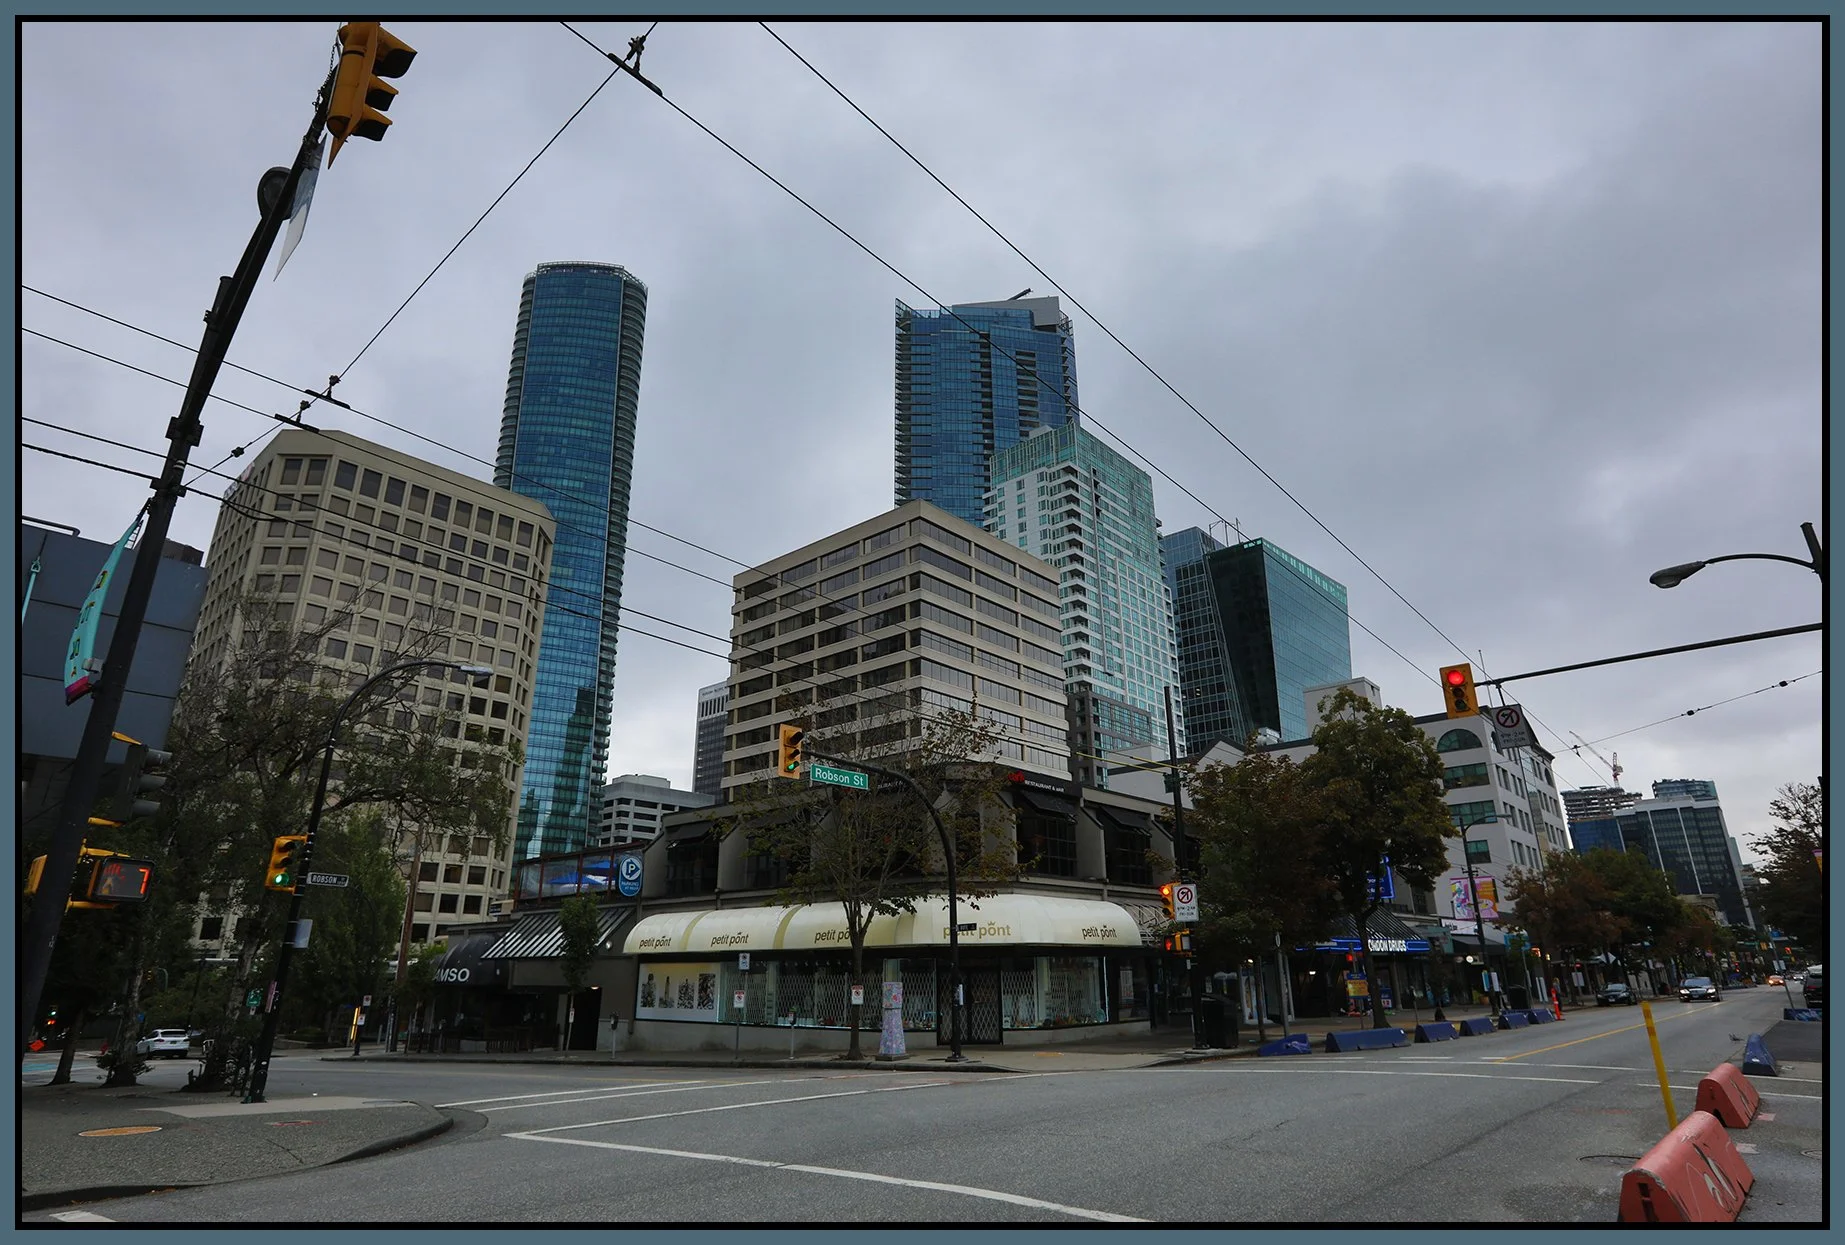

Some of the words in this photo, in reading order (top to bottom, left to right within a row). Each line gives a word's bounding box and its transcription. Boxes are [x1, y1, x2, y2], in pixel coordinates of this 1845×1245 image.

[815, 768, 850, 783] Robson
[853, 775, 864, 786] St
[312, 875, 338, 884] ROBSON
[814, 929, 835, 943] petit
[1082, 927, 1099, 940] petit
[639, 937, 655, 949] petit
[711, 935, 729, 947] petit
[1388, 939, 1407, 952] DRUGS
